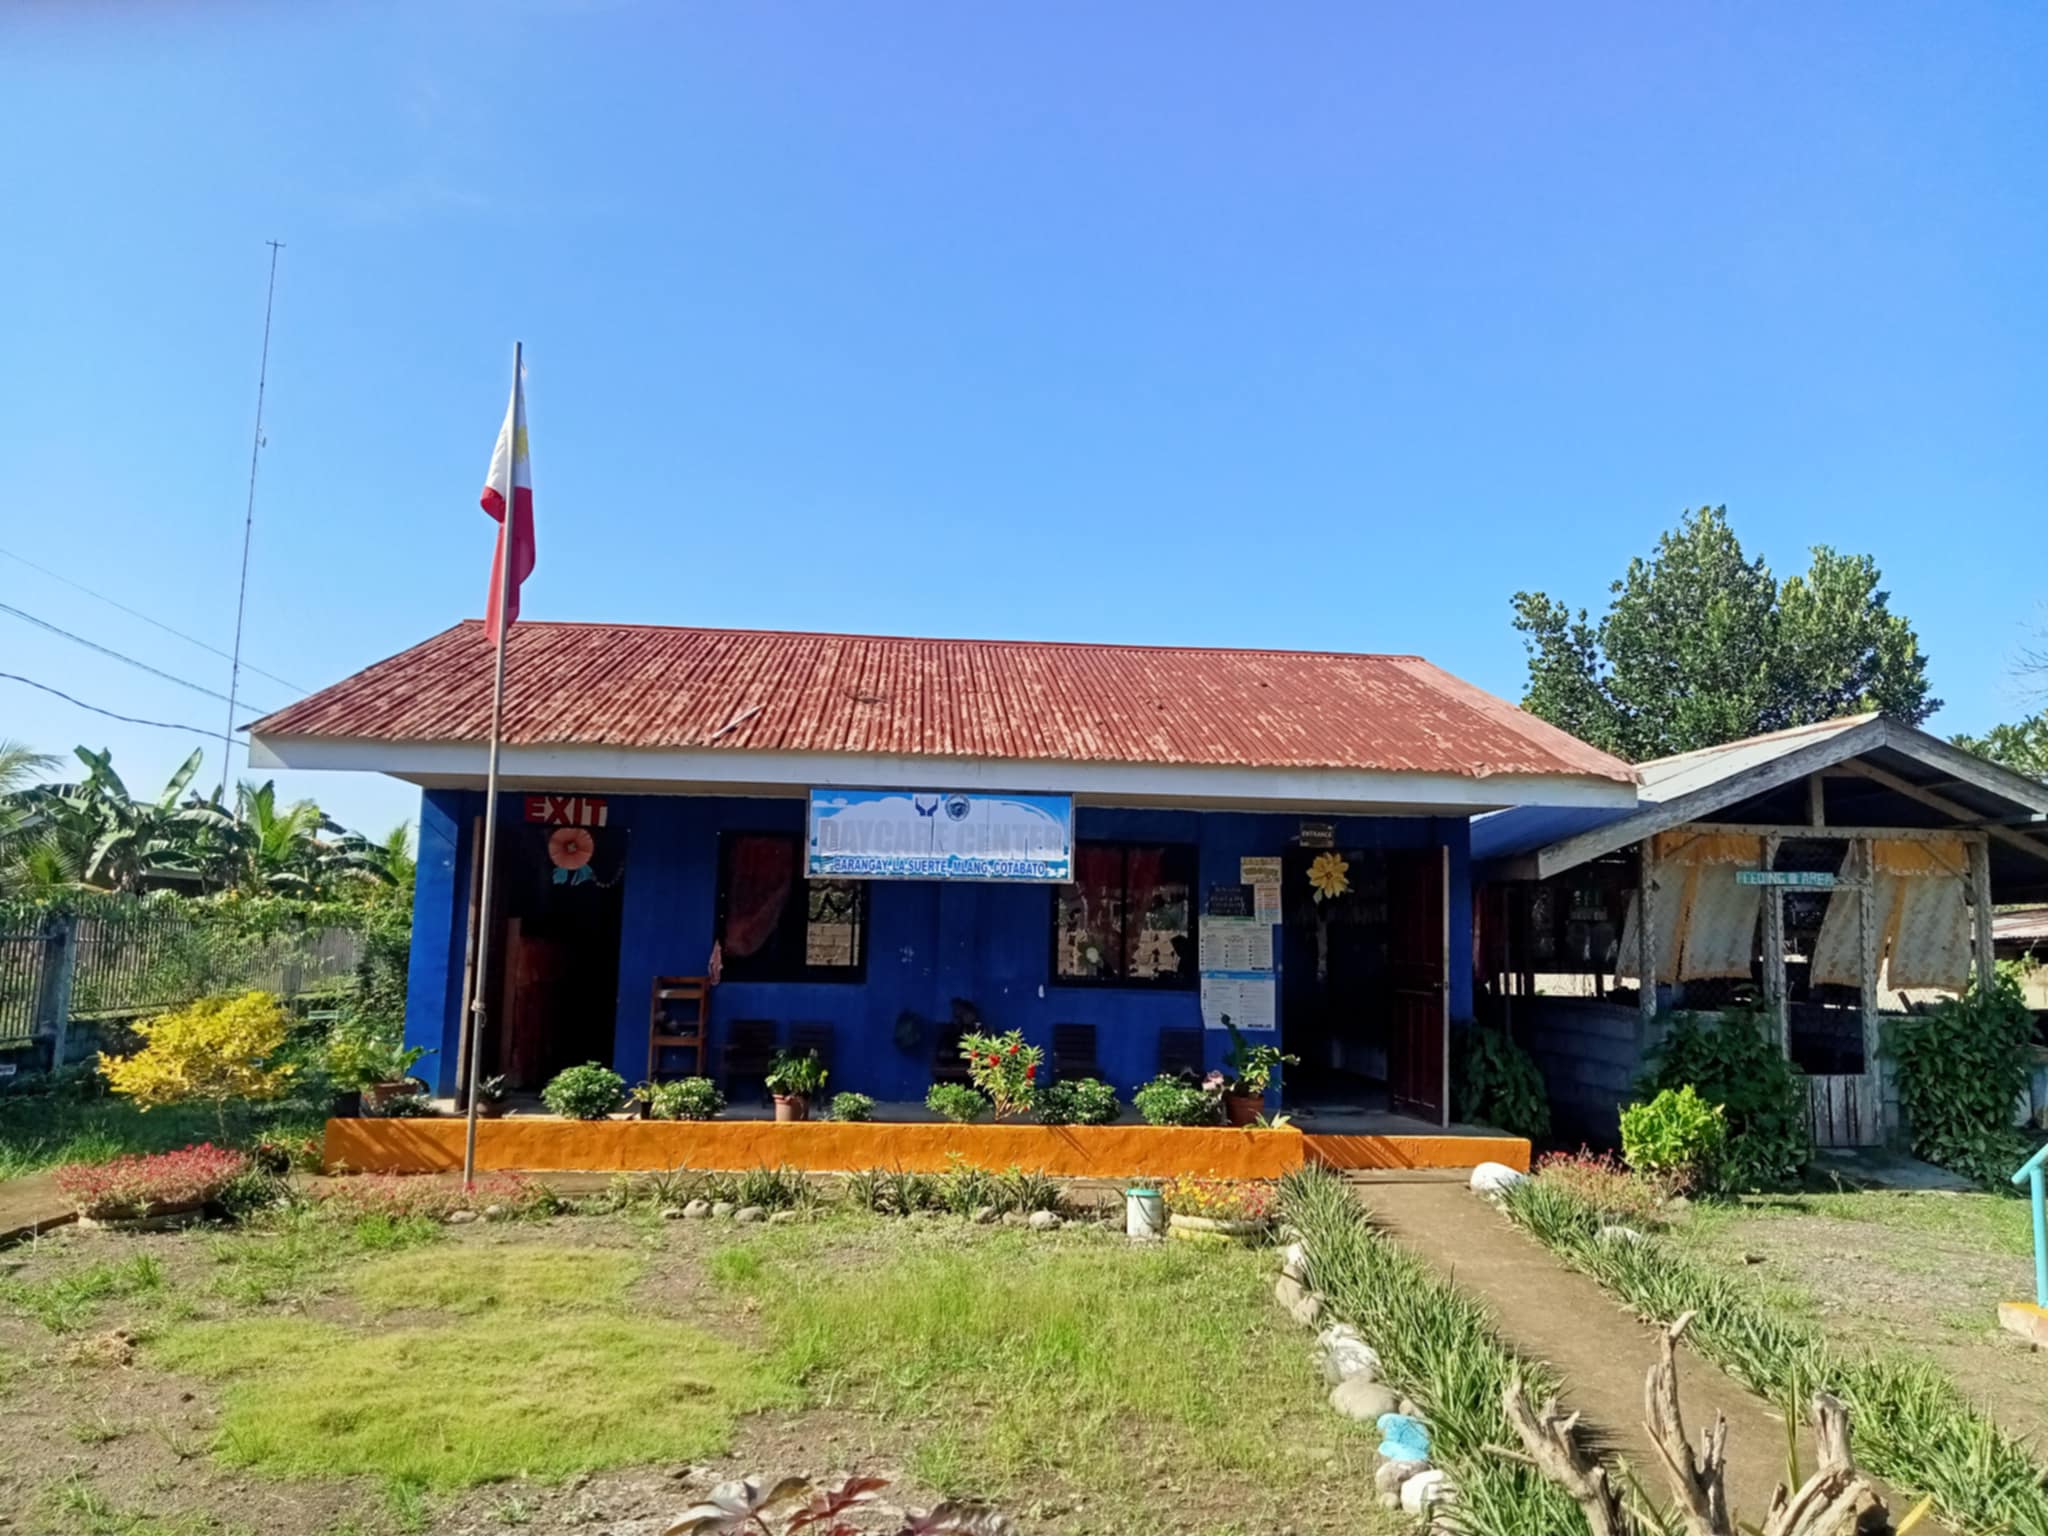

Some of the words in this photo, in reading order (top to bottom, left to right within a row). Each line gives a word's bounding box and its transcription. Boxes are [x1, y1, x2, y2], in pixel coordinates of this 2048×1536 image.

[525, 797, 607, 826] EXIT
[819, 819, 949, 854] DAYCARE
[956, 823, 1062, 855] CENTER
[893, 859, 905, 872] LA
[994, 861, 1046, 875] COTABATO
